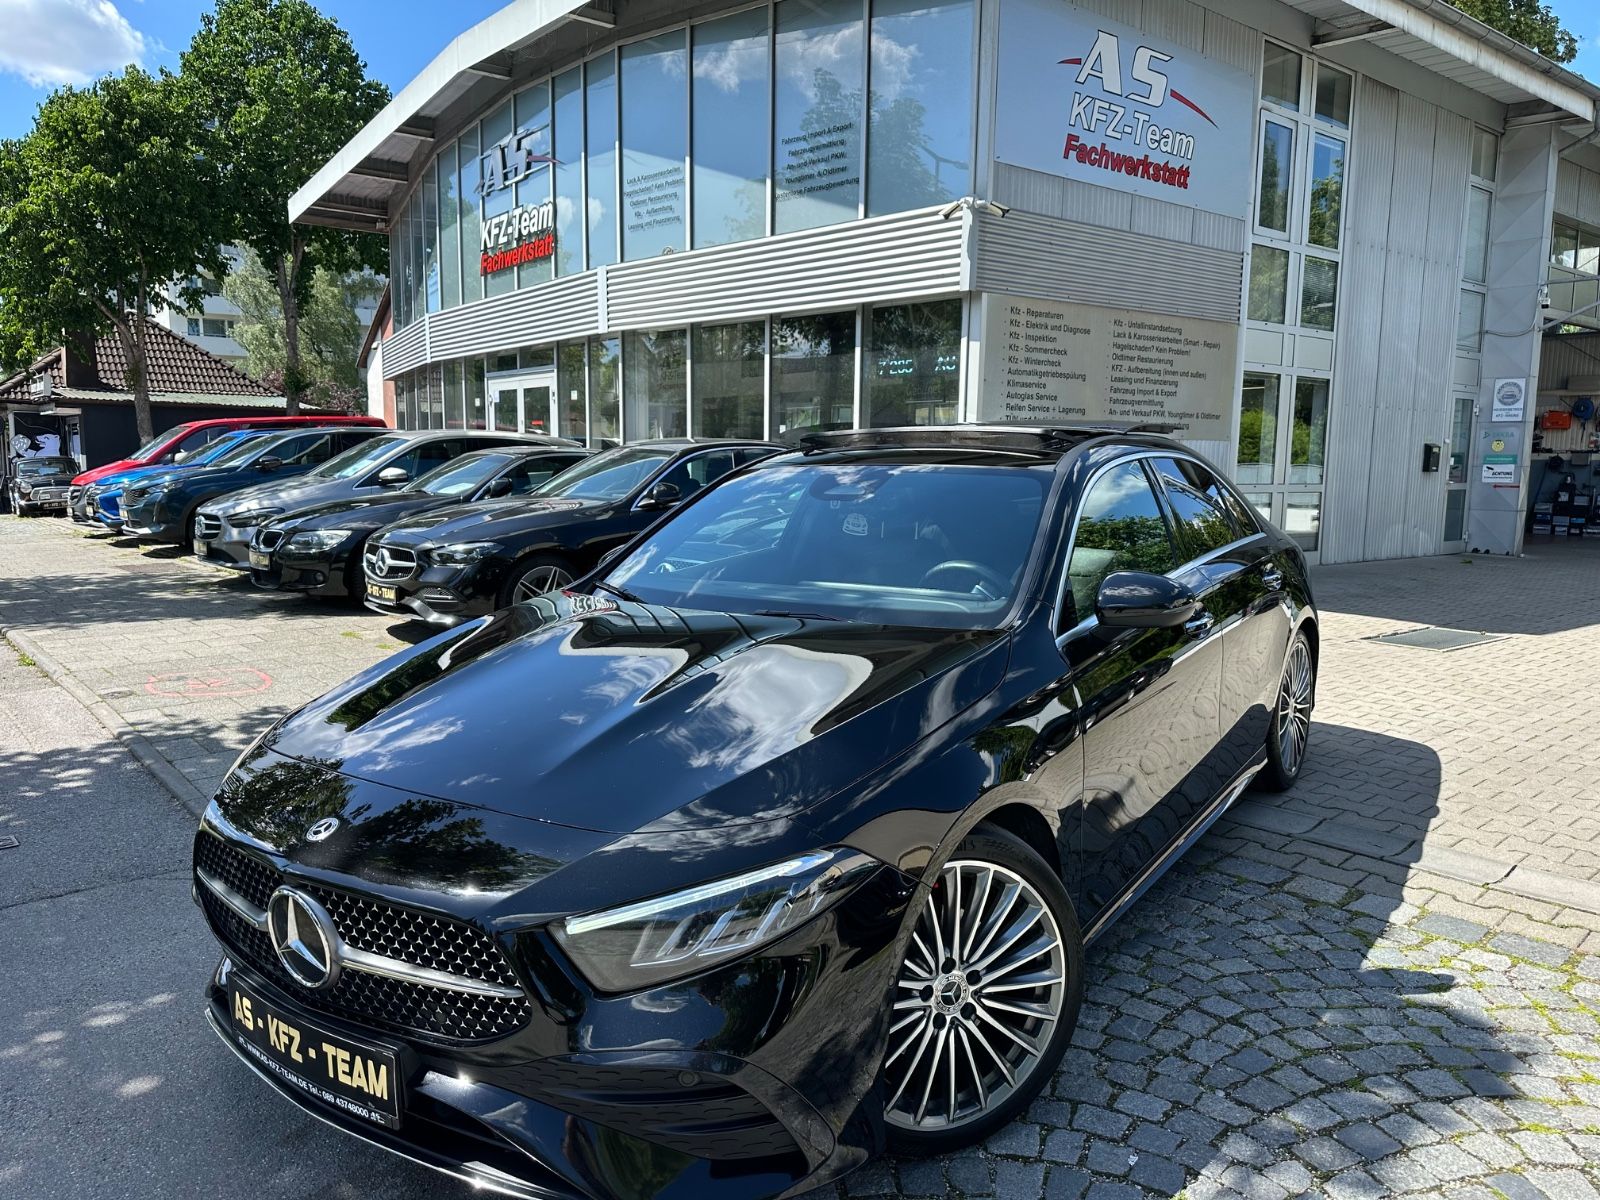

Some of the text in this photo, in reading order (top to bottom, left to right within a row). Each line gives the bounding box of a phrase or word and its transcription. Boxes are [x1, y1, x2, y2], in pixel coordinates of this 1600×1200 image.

[1075, 29, 1174, 108] AS
[1069, 91, 1195, 160] KFZ-Team
[781, 134, 807, 145] Fahrzeug
[807, 128, 826, 138] Import
[832, 122, 852, 133] Export
[481, 129, 531, 197] AS
[1063, 133, 1190, 189] Fachwerkstatt
[480, 201, 554, 250] KFZ-Team
[480, 233, 554, 277] Fachwerkstatt
[1010, 306, 1021, 315] Kfz
[1026, 308, 1064, 320] Reparaturen
[1009, 319, 1021, 328] Kfz
[1025, 320, 1049, 330] Elektrik
[1050, 323, 1062, 332] und
[1063, 324, 1091, 335] Diagnose
[1113, 319, 1123, 327] Kfz
[1127, 321, 1182, 335] Unfallinstandsetzung
[1009, 331, 1020, 340] Kfz
[1025, 332, 1057, 343] Inspektion
[1113, 330, 1126, 339] Lack
[1008, 343, 1019, 352] Kfz
[1024, 344, 1068, 356] Sommercheck
[1112, 341, 1154, 353] Hagelschaden?
[1155, 346, 1167, 354] Kein
[1008, 355, 1019, 364] Kfz
[1024, 357, 1061, 367] Wintercheck
[1112, 353, 1174, 367] Oldtimer Restaurierung
[1111, 364, 1123, 373] KFZ
[1179, 370, 1190, 378] und
[1007, 379, 1047, 390] Klimaservice
[1110, 375, 1179, 388] Leasing und Finanzierung
[1006, 391, 1058, 401] Autoglas Service
[1109, 385, 1136, 396] Fahrzeug
[1136, 387, 1154, 397] Import
[1160, 389, 1177, 398] Export
[1005, 402, 1026, 412] Reifen
[1027, 403, 1050, 413] Service
[1058, 406, 1086, 416] Lagerung
[1131, 409, 1152, 417] Verkauf
[235, 990, 254, 1031] AS
[267, 1013, 303, 1064] KFZ
[322, 1042, 388, 1100] TEAM
[322, 1090, 335, 1103] 089
[335, 1097, 369, 1118] 43748000
